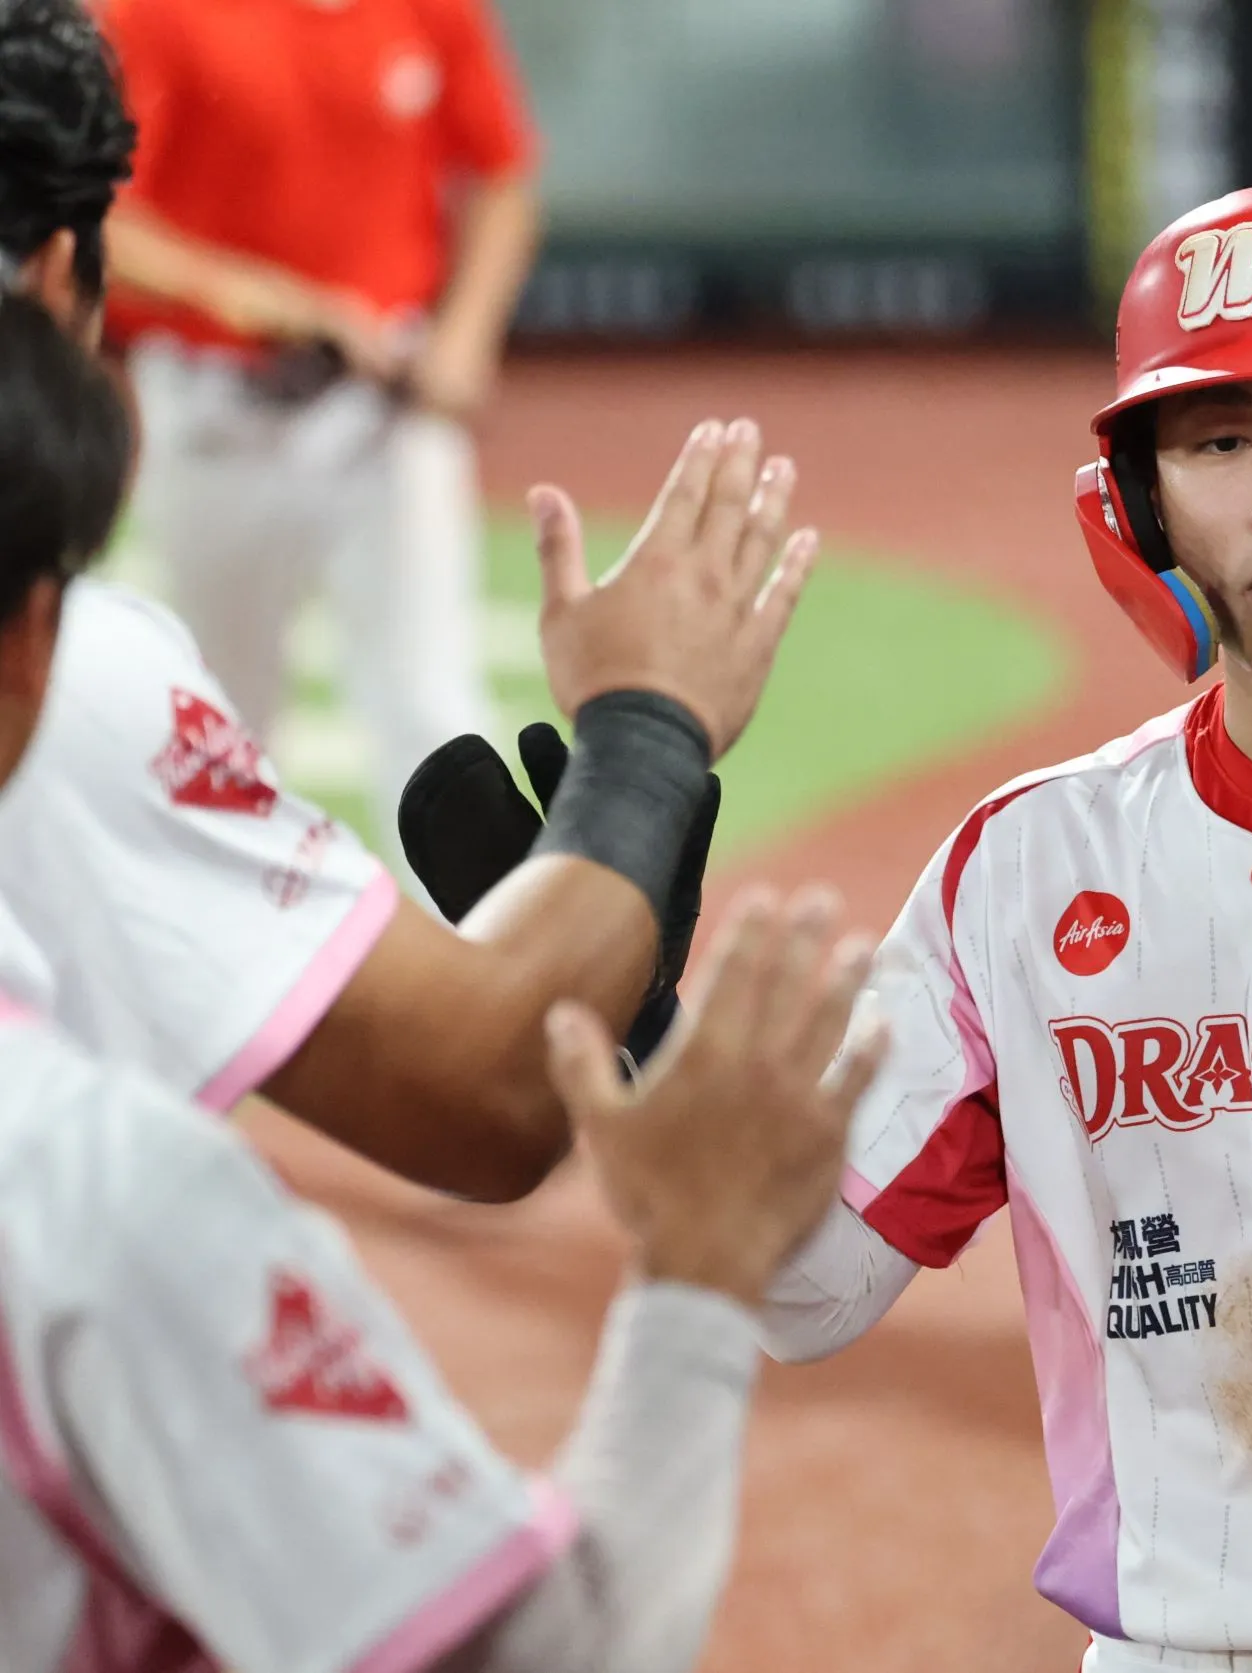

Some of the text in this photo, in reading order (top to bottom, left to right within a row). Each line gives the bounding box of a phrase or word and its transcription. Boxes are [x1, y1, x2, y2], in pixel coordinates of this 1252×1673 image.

[1059, 915, 1125, 953] AirAsia
[1109, 1262, 1166, 1300] HIH
[1163, 1259, 1217, 1288] 高品質
[1106, 1293, 1218, 1340] QUALITY
